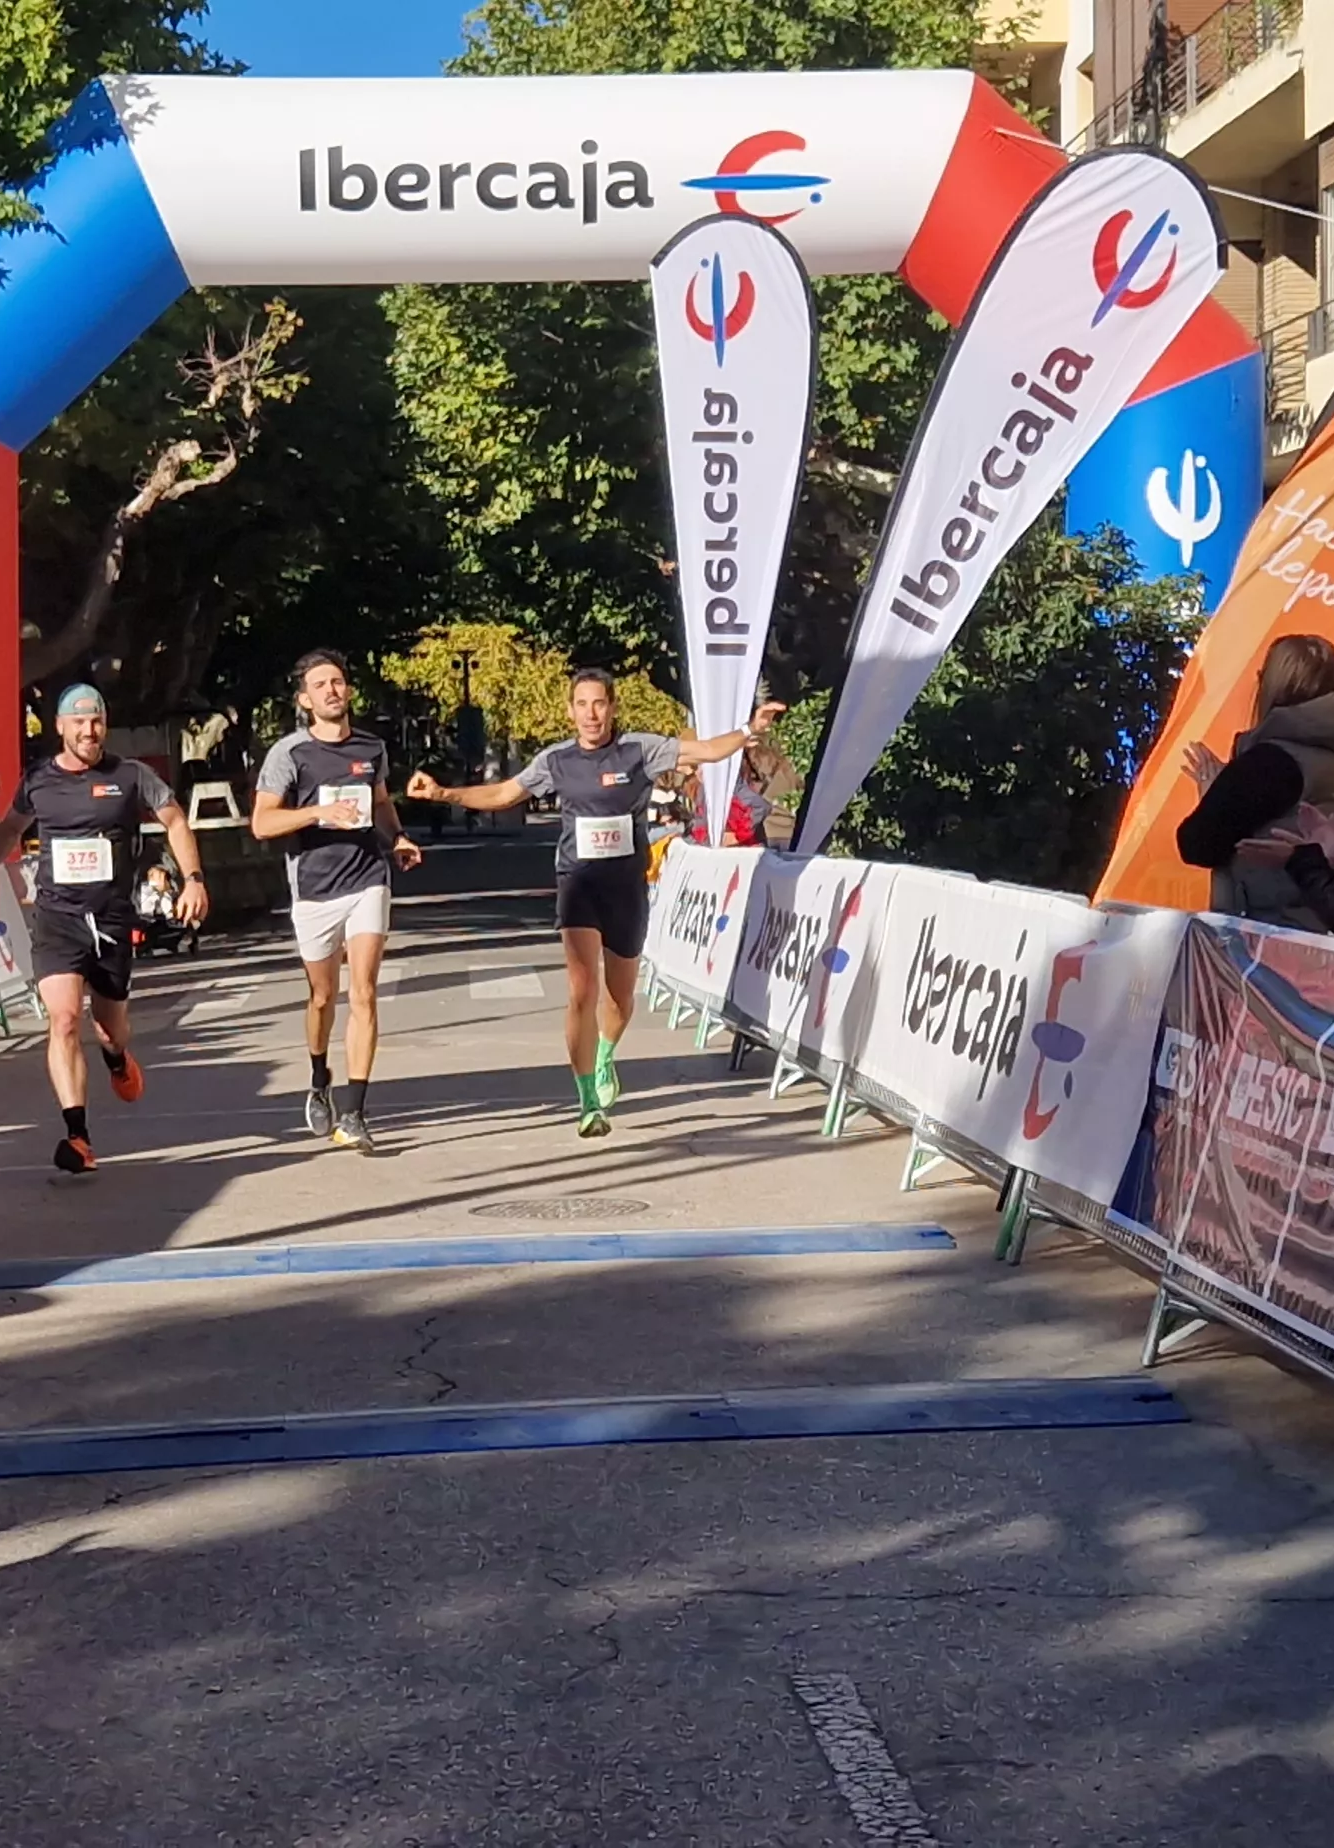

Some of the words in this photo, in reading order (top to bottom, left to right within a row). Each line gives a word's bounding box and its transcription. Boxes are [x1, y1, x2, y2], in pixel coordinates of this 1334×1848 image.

[299, 138, 654, 223] Ibercaja
[889, 344, 1094, 637] Ibercaja
[67, 851, 98, 865] 375
[590, 830, 621, 843] 376
[901, 914, 1030, 1101] Ibercaja
[1244, 1057, 1310, 1140] ESIC
